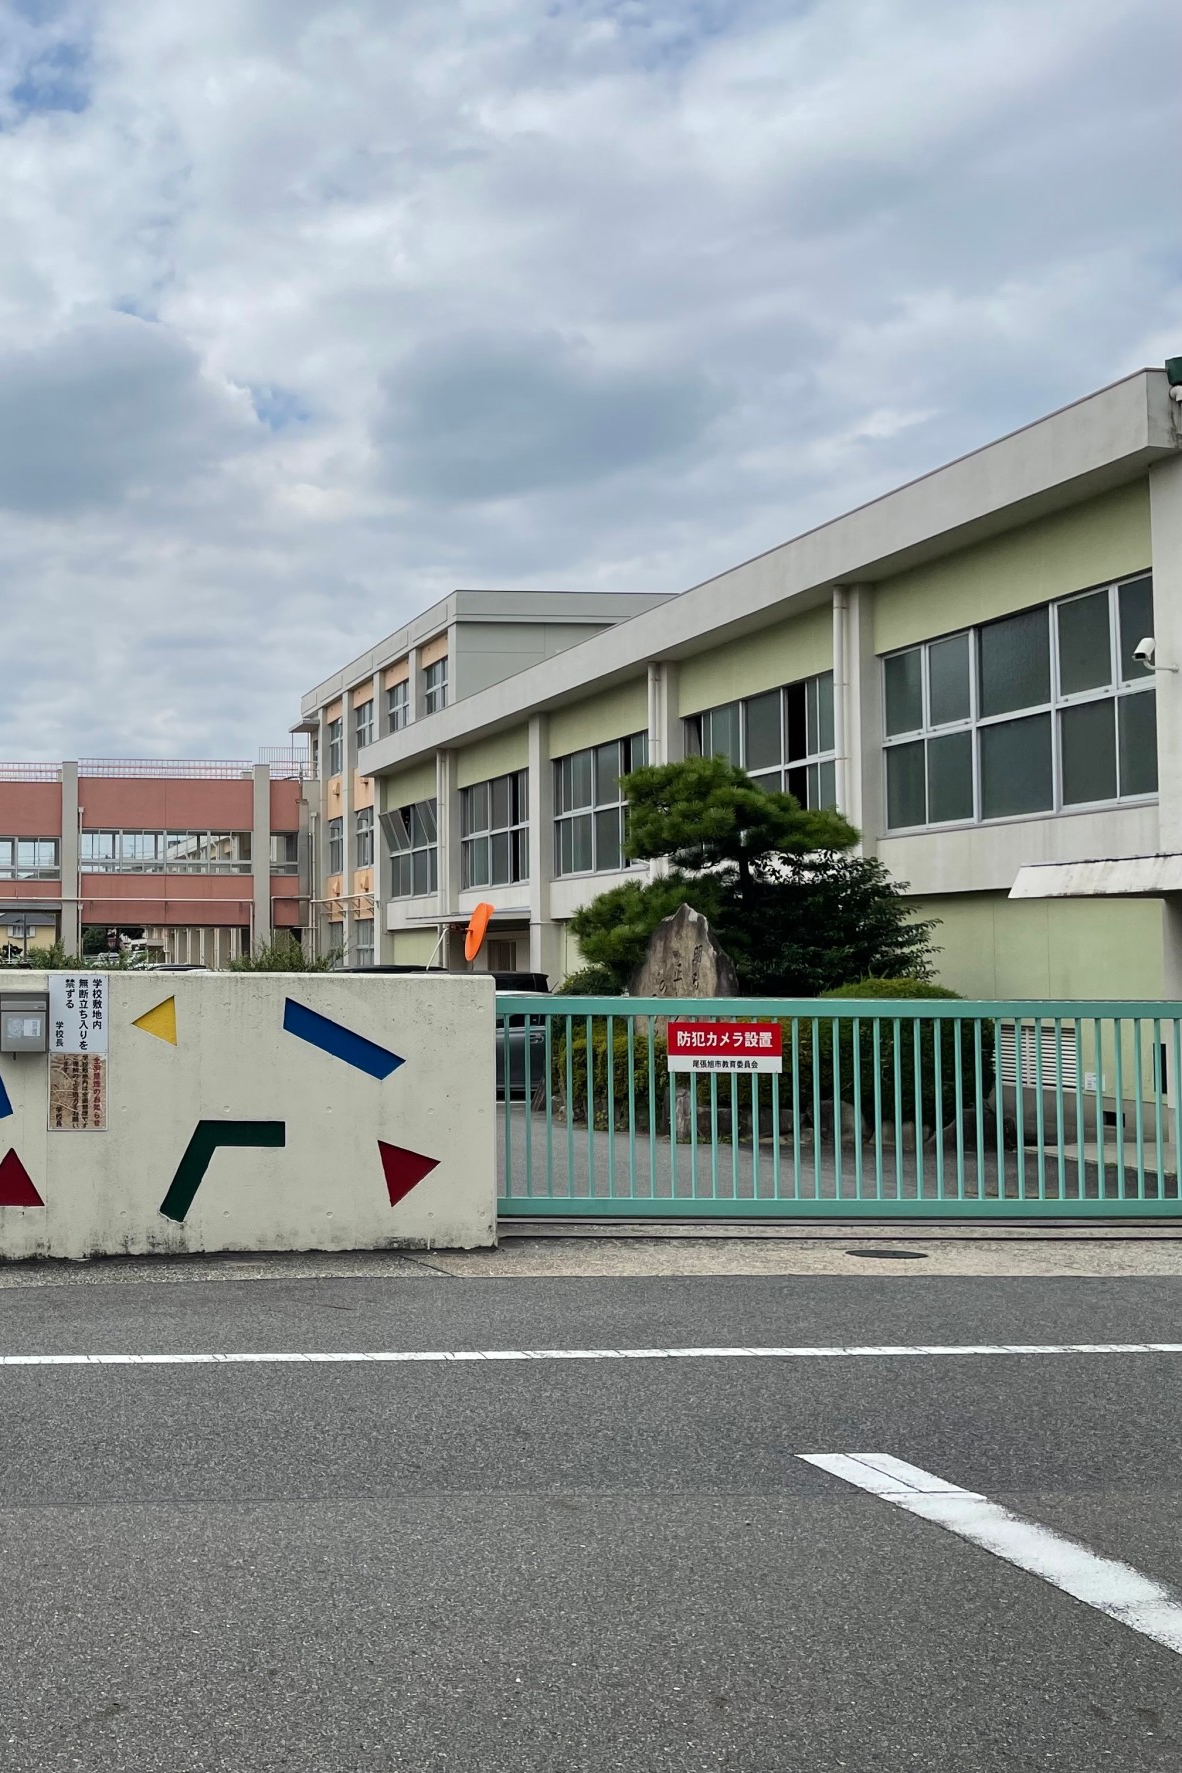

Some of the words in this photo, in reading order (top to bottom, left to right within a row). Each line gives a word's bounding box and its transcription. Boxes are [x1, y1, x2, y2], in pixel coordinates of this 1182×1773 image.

[65, 978, 75, 1009] 禁ずる
[92, 978, 102, 1030] 学校敷地内
[78, 978, 89, 1050] 無断立ち入りを
[55, 1021, 64, 1047] 学校長
[676, 1031, 773, 1048] 防犯カメラ設置
[692, 1059, 759, 1069] 尾張旭市教育委員会
